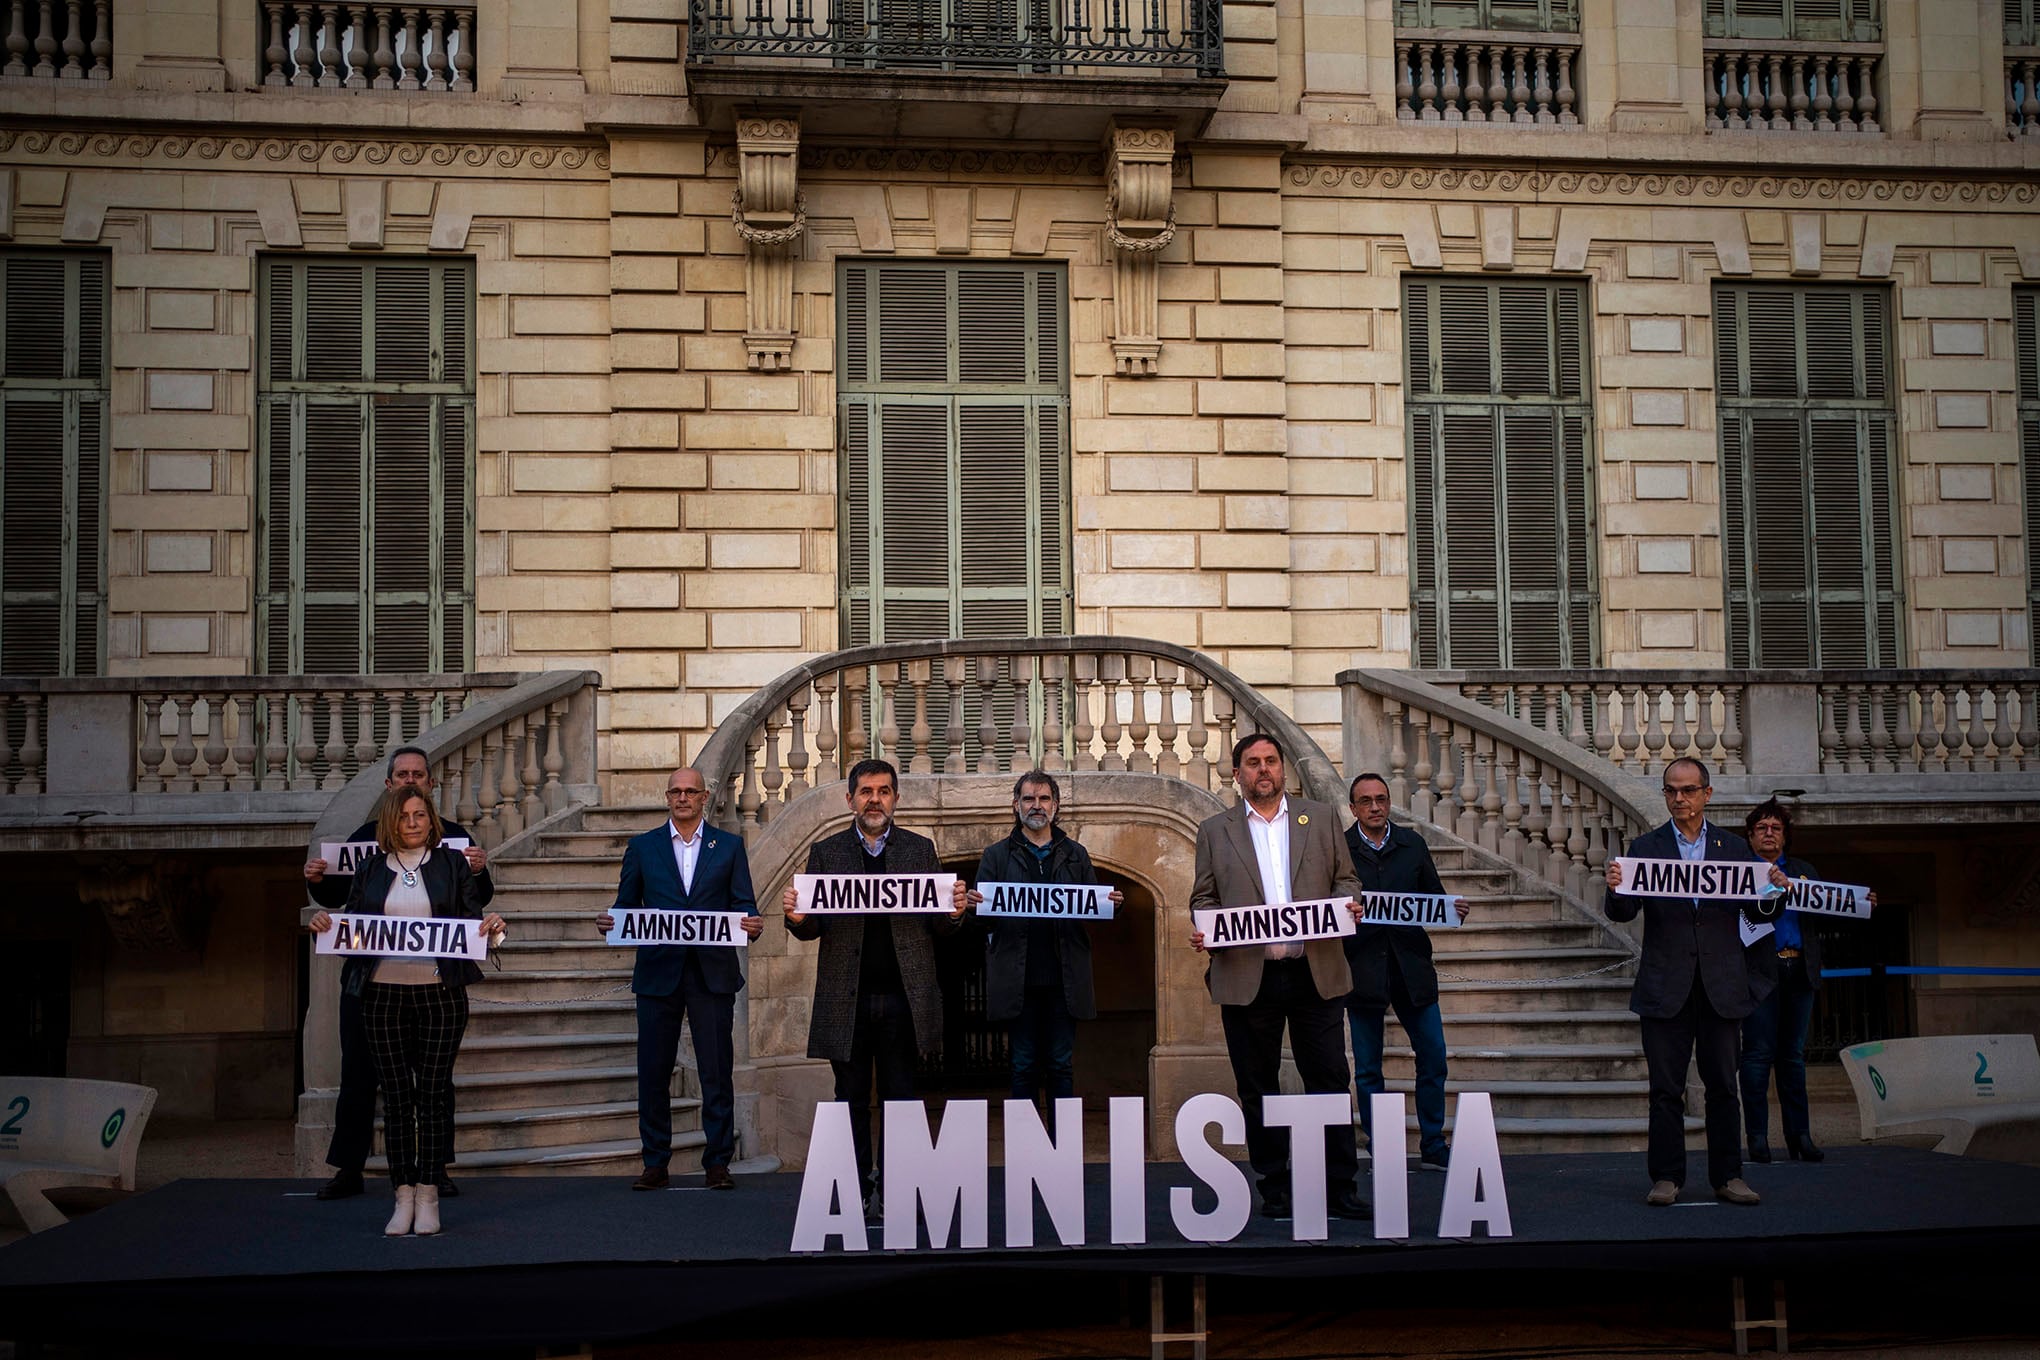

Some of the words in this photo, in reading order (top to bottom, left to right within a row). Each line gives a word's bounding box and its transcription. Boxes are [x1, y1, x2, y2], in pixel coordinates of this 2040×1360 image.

[811, 878, 939, 909] AMNISTIA
[1631, 862, 1757, 896] AMNISTIA
[991, 886, 1099, 915] AMNISTIA
[1361, 896, 1446, 923] MNISTIA
[1787, 883, 1856, 913] NISTIA
[333, 918, 468, 954] AMNISTIA
[621, 913, 732, 942] AMNISTIA
[1213, 903, 1339, 942] AMNISTIA
[1975, 1051, 1993, 1084] 2
[0, 1096, 30, 1135] 2
[790, 1093, 1513, 1252] AMNISTIA
